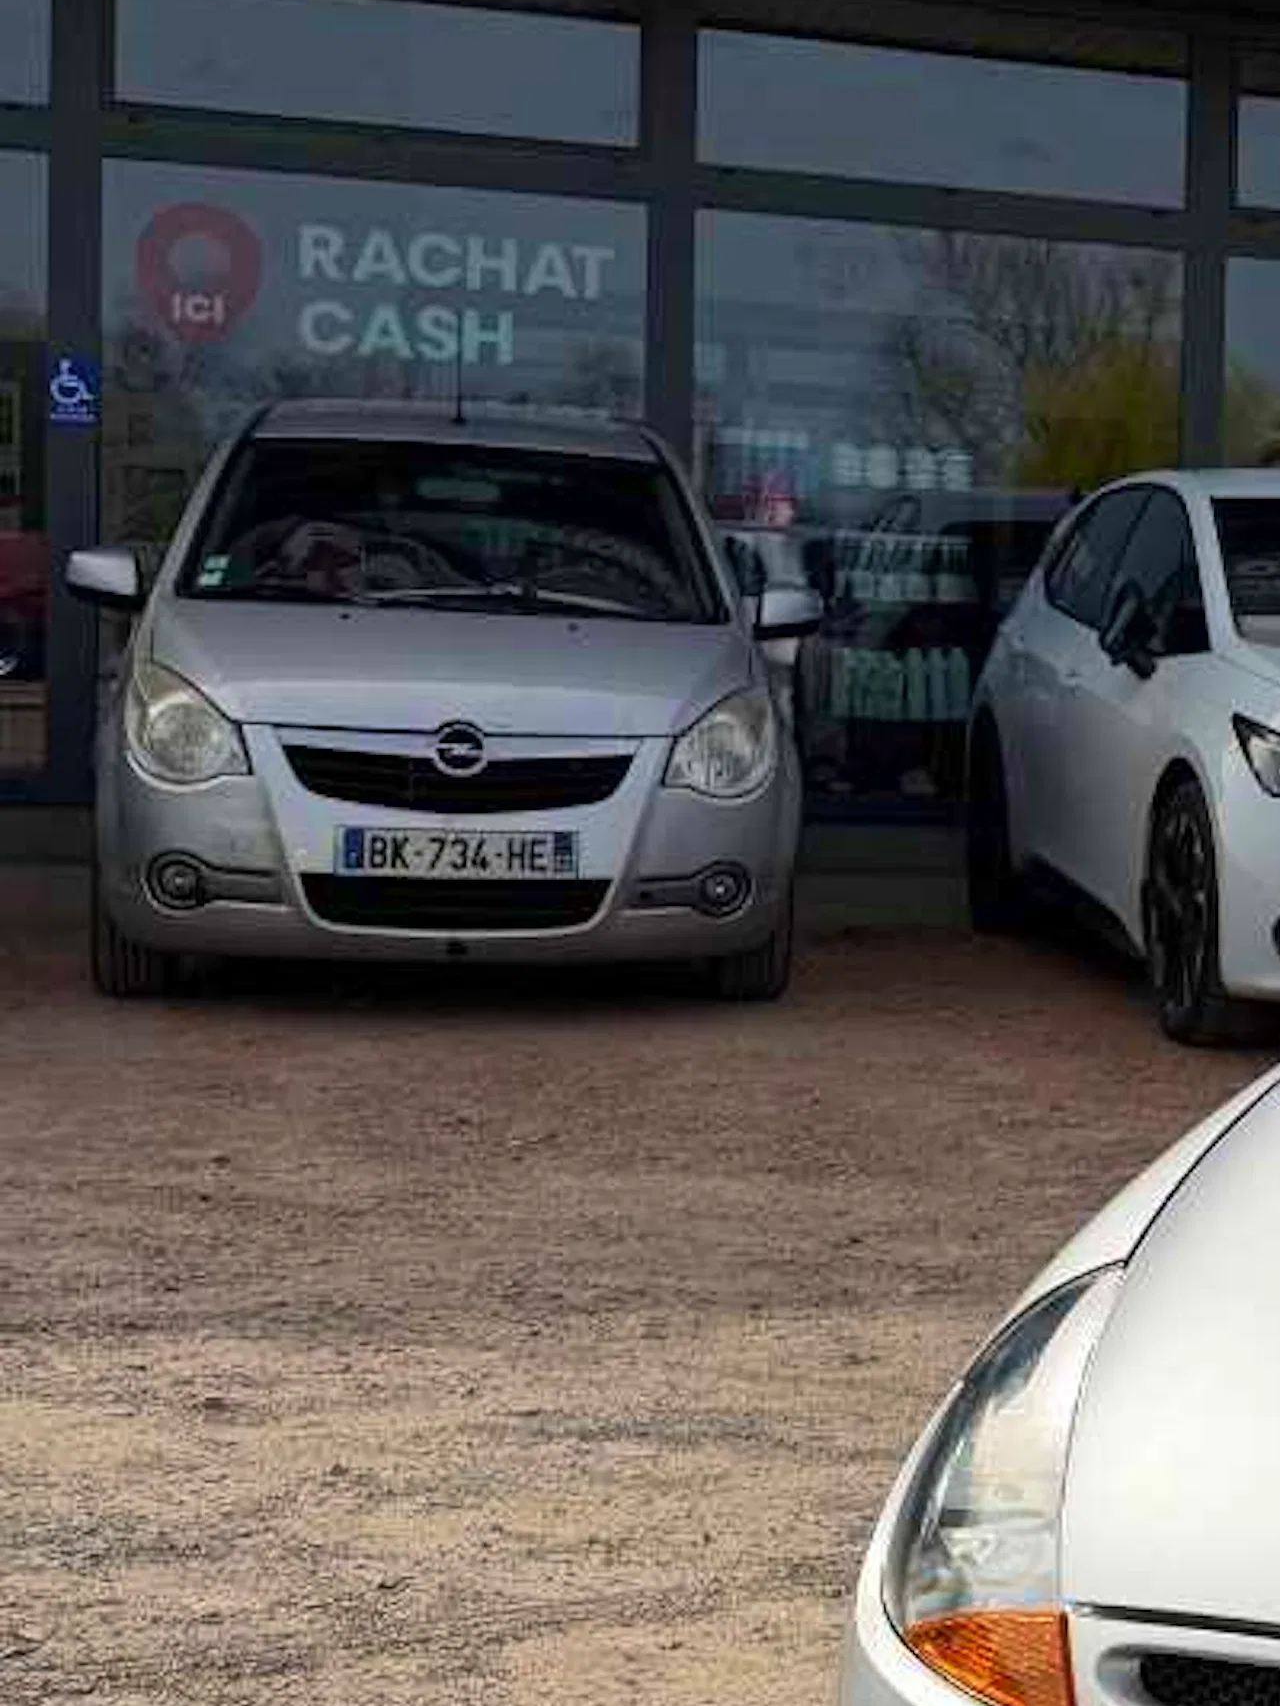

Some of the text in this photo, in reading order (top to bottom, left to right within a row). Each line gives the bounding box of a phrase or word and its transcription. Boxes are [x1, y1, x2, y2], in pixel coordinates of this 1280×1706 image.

[298, 223, 616, 300] RACHAT
[300, 300, 516, 366] CASH
[369, 836, 547, 872] BK-734-HE
